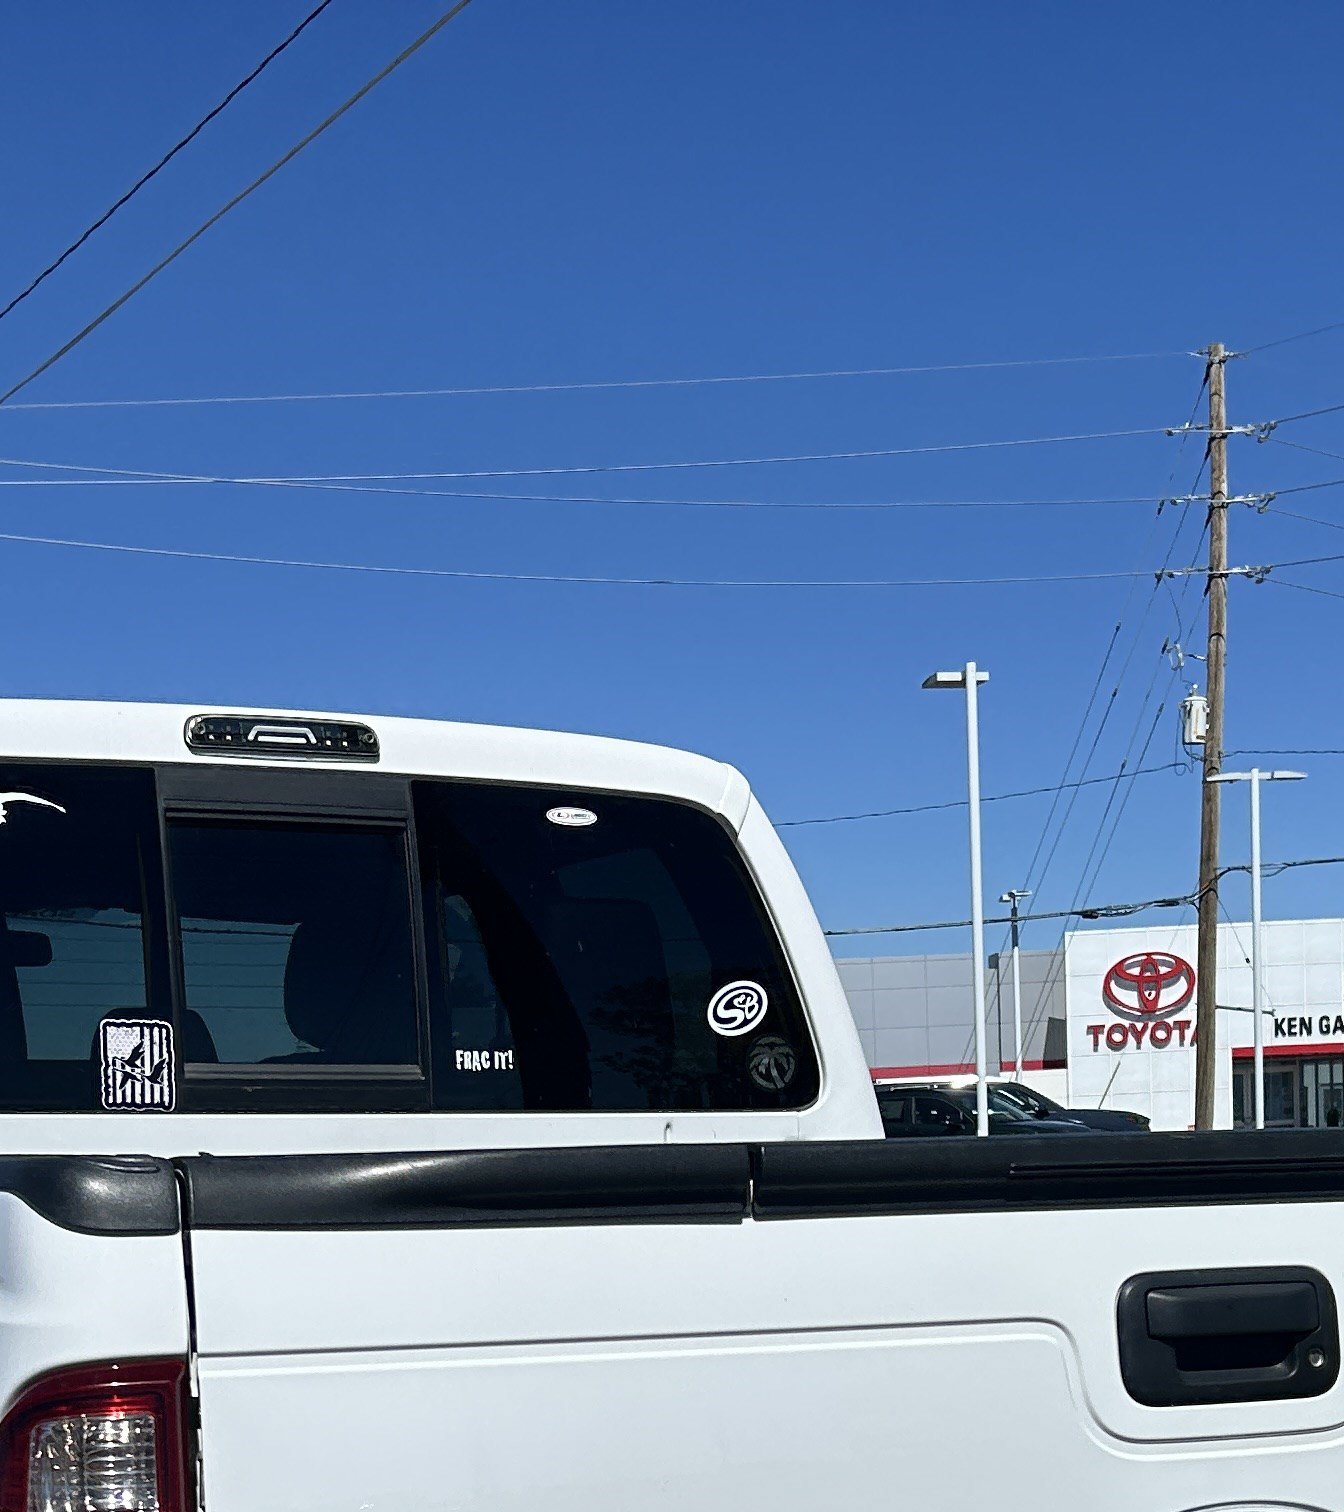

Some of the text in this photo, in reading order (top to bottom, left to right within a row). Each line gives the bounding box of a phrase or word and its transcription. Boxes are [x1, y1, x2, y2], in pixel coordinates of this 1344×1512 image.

[1274, 1016, 1312, 1037] KEN
[456, 1049, 514, 1071] FRAC IT!
